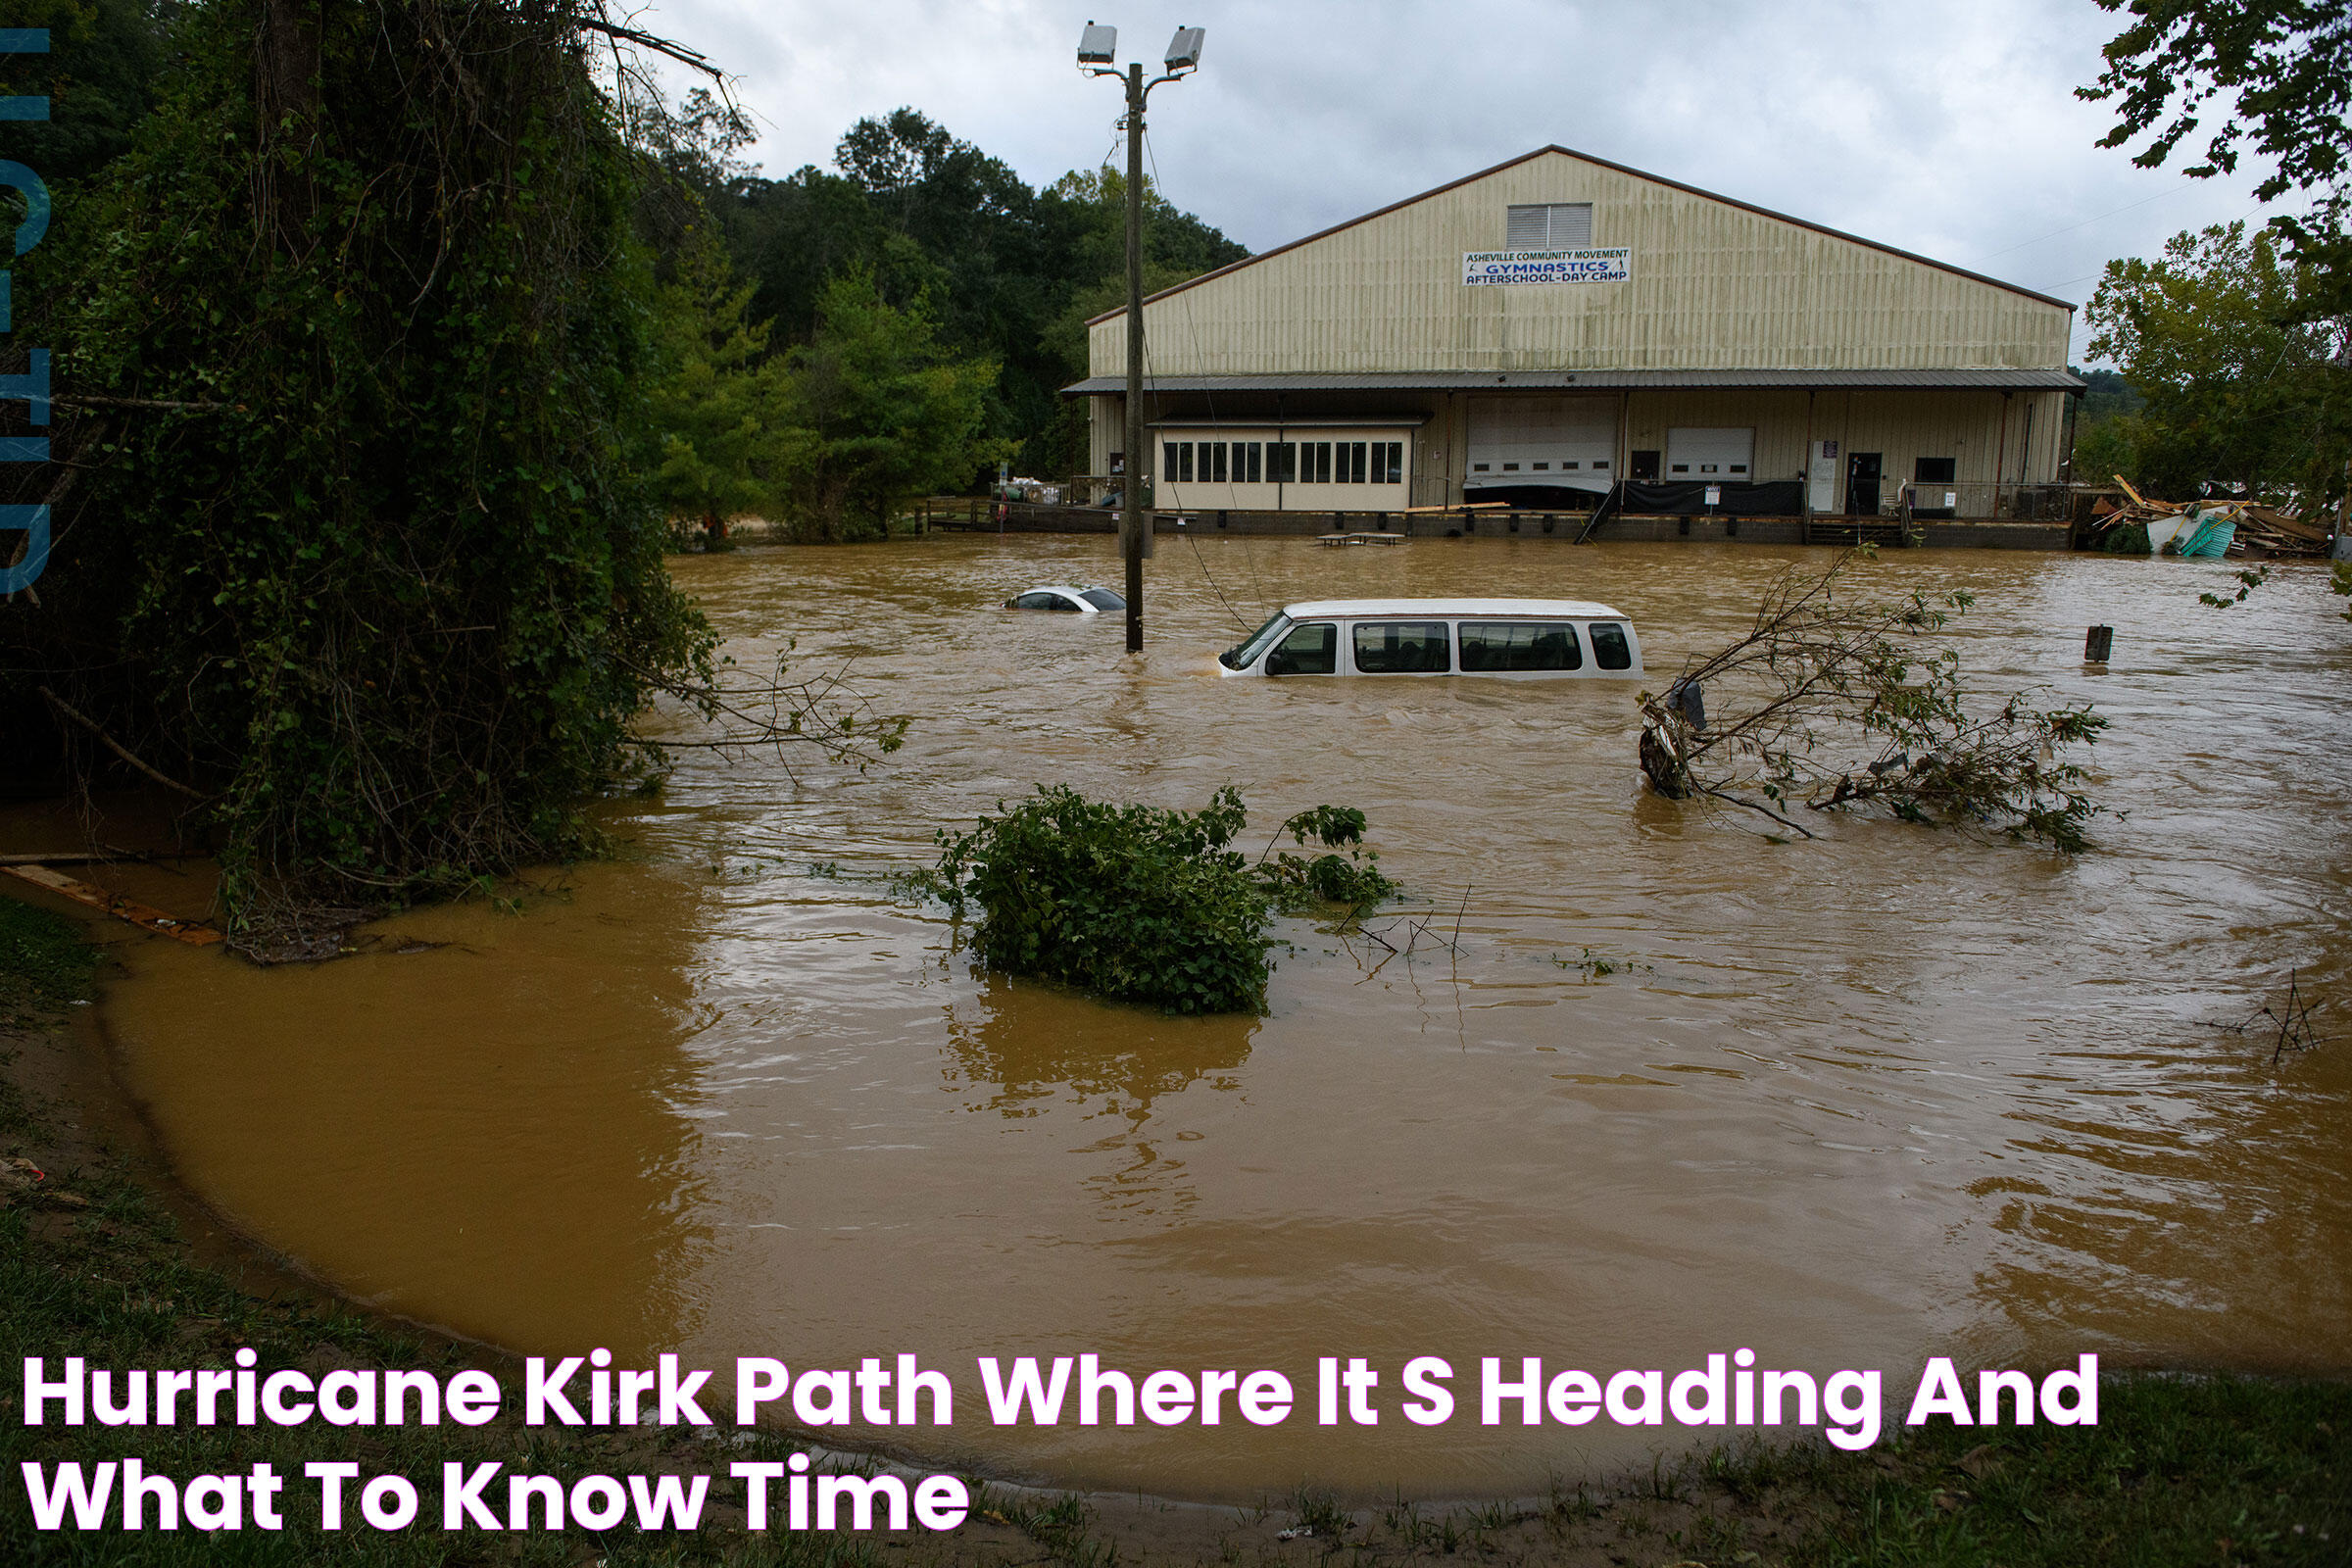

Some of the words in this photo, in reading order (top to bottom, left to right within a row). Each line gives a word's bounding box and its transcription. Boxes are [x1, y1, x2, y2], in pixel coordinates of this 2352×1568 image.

[1467, 253, 1514, 262] ASHEVILLE
[1516, 251, 1573, 261] COMMUNITY
[1574, 249, 1629, 259] MOVEMENT
[1486, 262, 1609, 273] GYMNASTICS
[1592, 271, 1627, 280] CAMP
